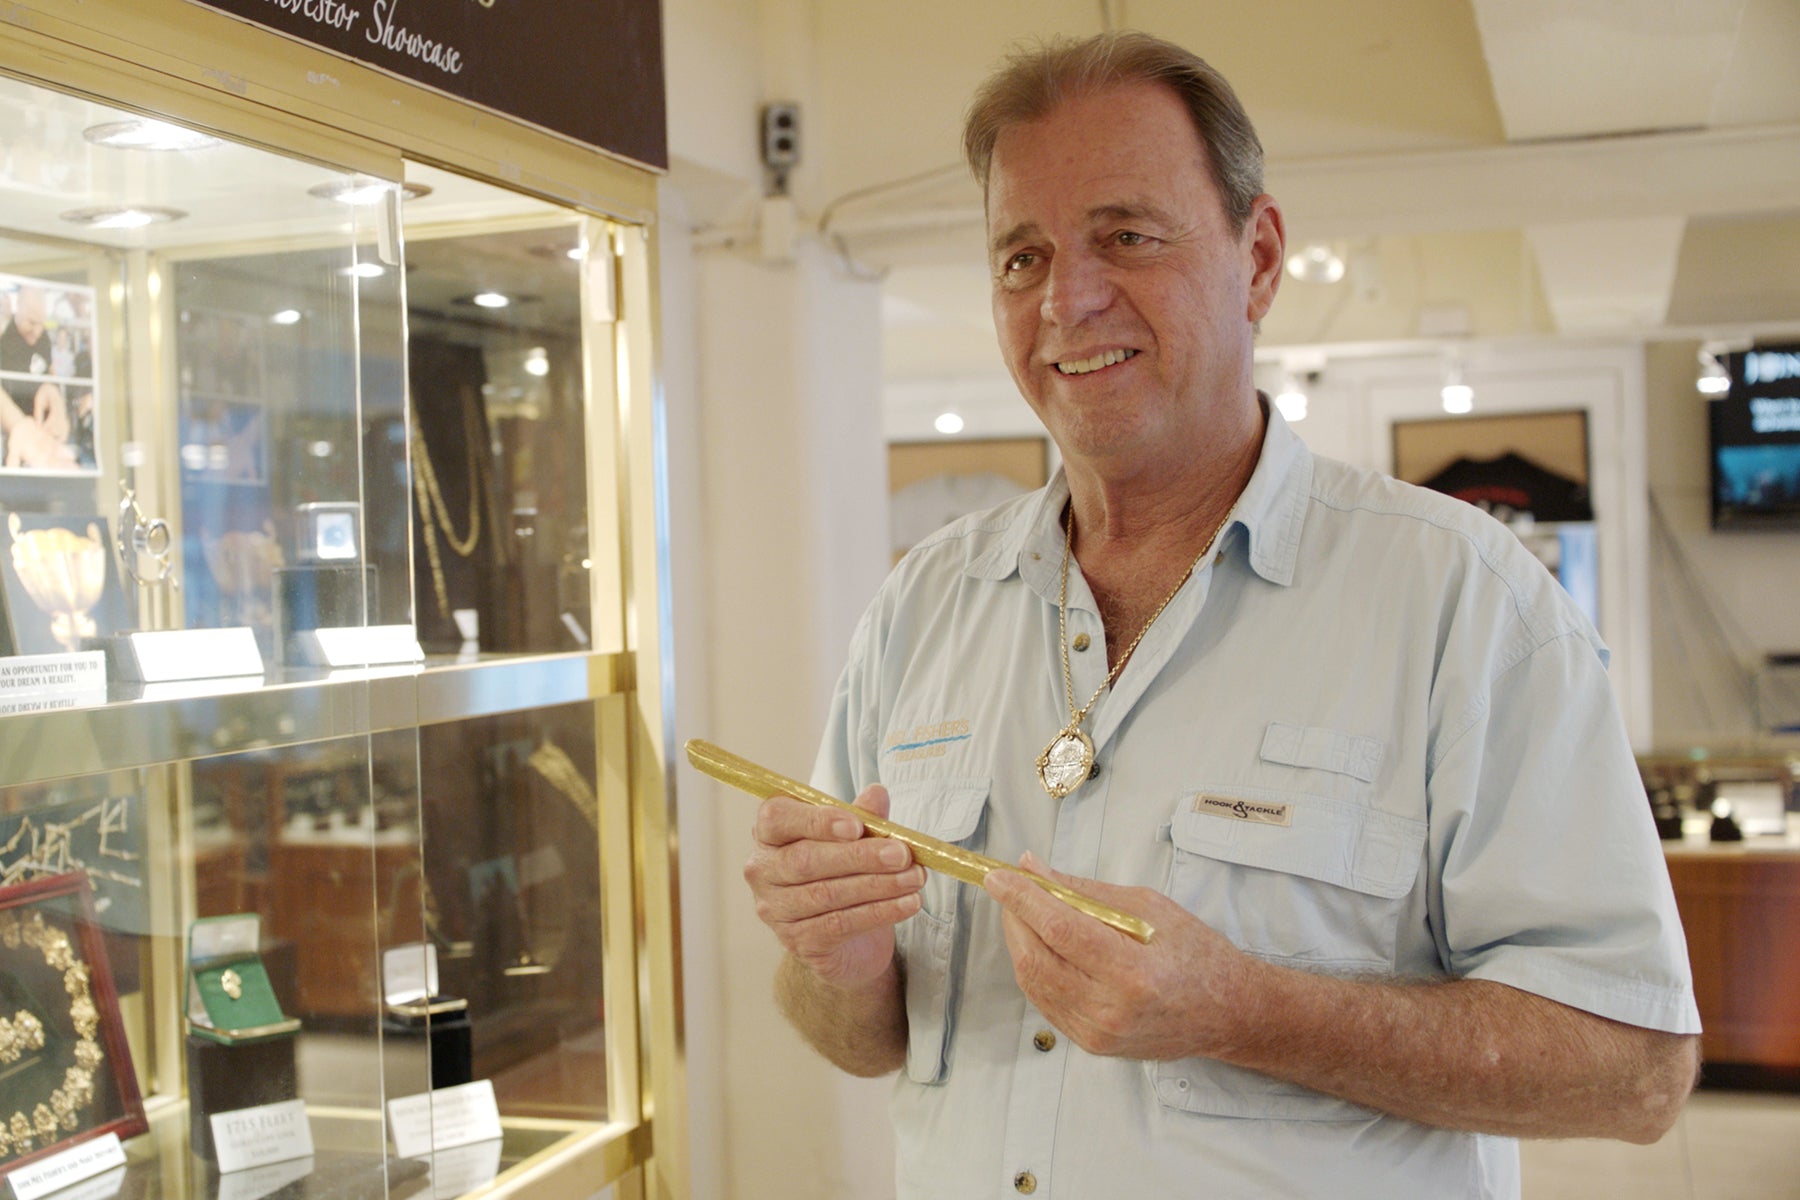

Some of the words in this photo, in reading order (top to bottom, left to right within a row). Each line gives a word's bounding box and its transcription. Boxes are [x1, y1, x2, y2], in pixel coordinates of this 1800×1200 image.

[265, 0, 360, 32] vestor
[364, 0, 464, 74] Showcase
[1, 667, 11, 676] AN
[12, 664, 58, 675] OPPORTUNITY
[60, 662, 73, 672] FOR
[74, 661, 88, 671] YOU
[89, 661, 98, 669] TO
[0, 679, 15, 688] OUR
[17, 676, 40, 687] DREAM
[42, 677, 47, 685] A
[1204, 799, 1232, 809] HOOK
[1245, 805, 1283, 816] TACKLE
